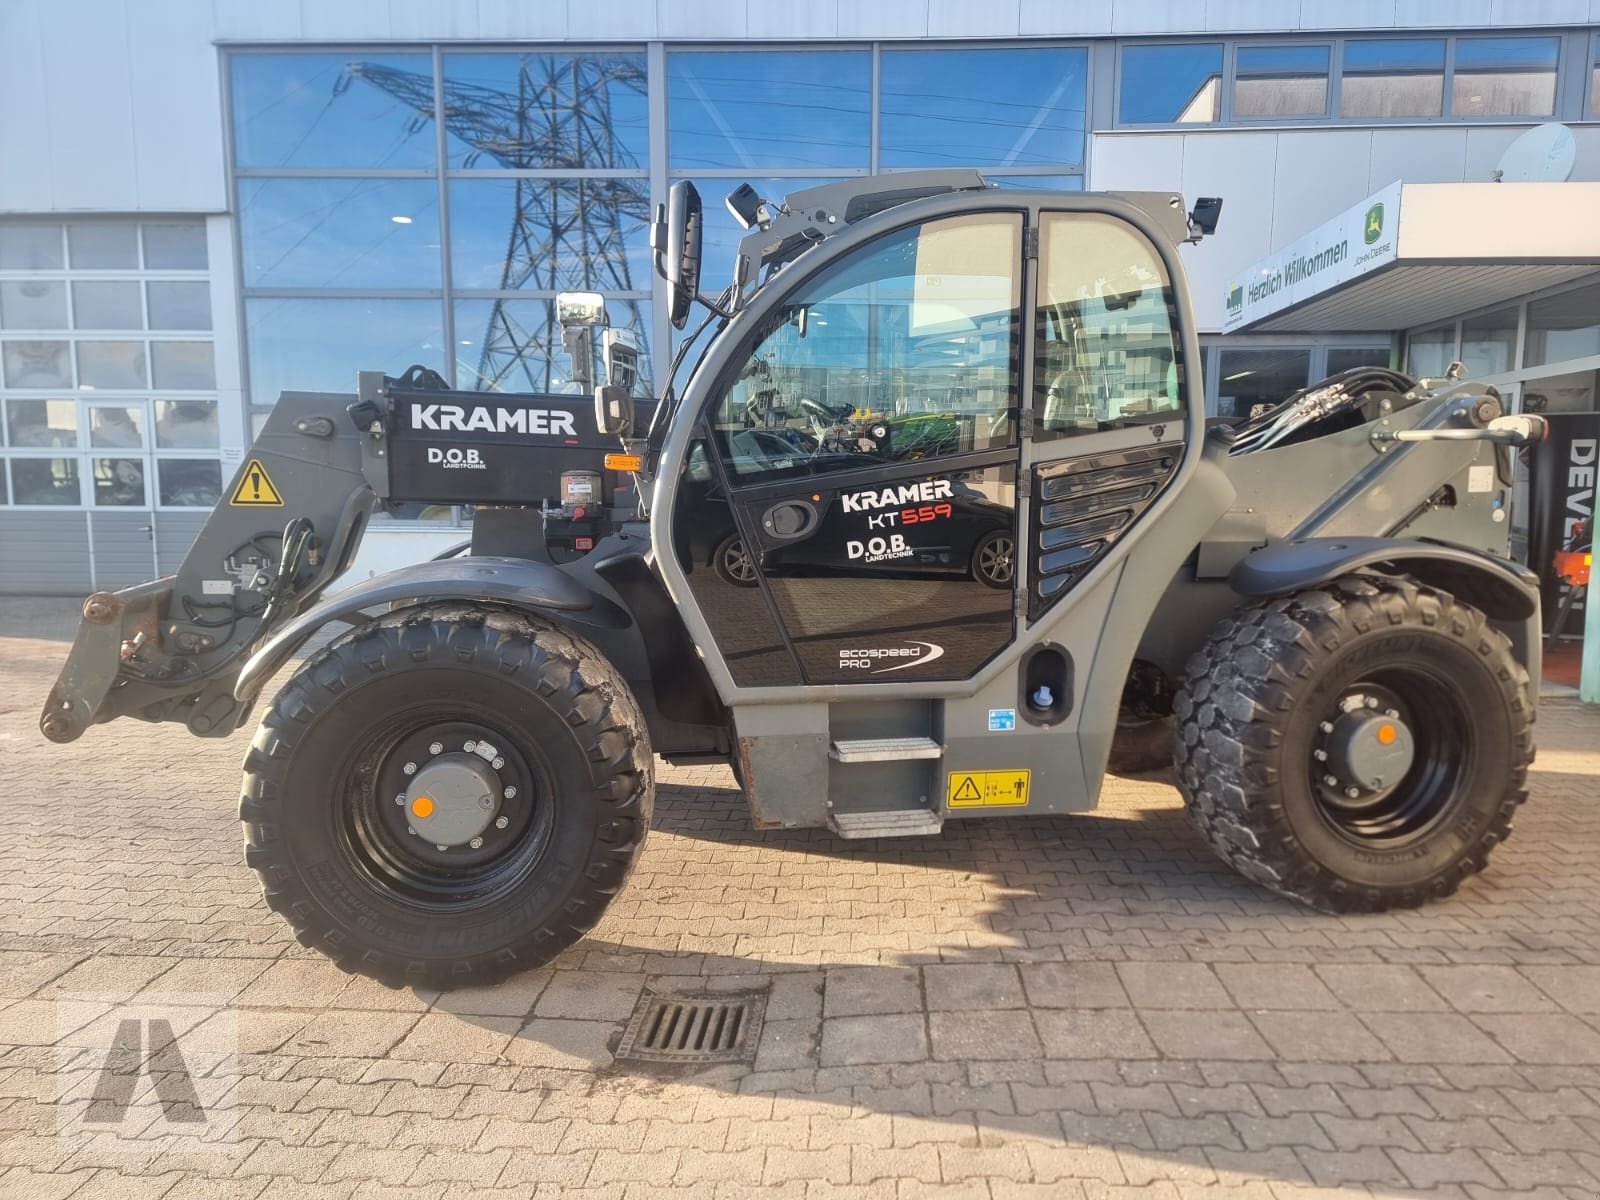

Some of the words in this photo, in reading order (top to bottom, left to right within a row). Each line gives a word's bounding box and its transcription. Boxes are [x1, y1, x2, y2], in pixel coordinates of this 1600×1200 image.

[1354, 253, 1370, 267] JOHN
[1370, 242, 1391, 259] DEERE
[1247, 270, 1282, 305] Herzlich
[1284, 239, 1348, 286] Willkommen
[411, 403, 577, 436] KRAMER
[427, 447, 485, 465] D.O.B.
[841, 479, 954, 513] KRAMER
[846, 534, 911, 560] D.O.B.
[865, 549, 914, 563] LANDTECHNIK
[839, 646, 920, 659] ecospeed
[839, 659, 871, 669] PRO
